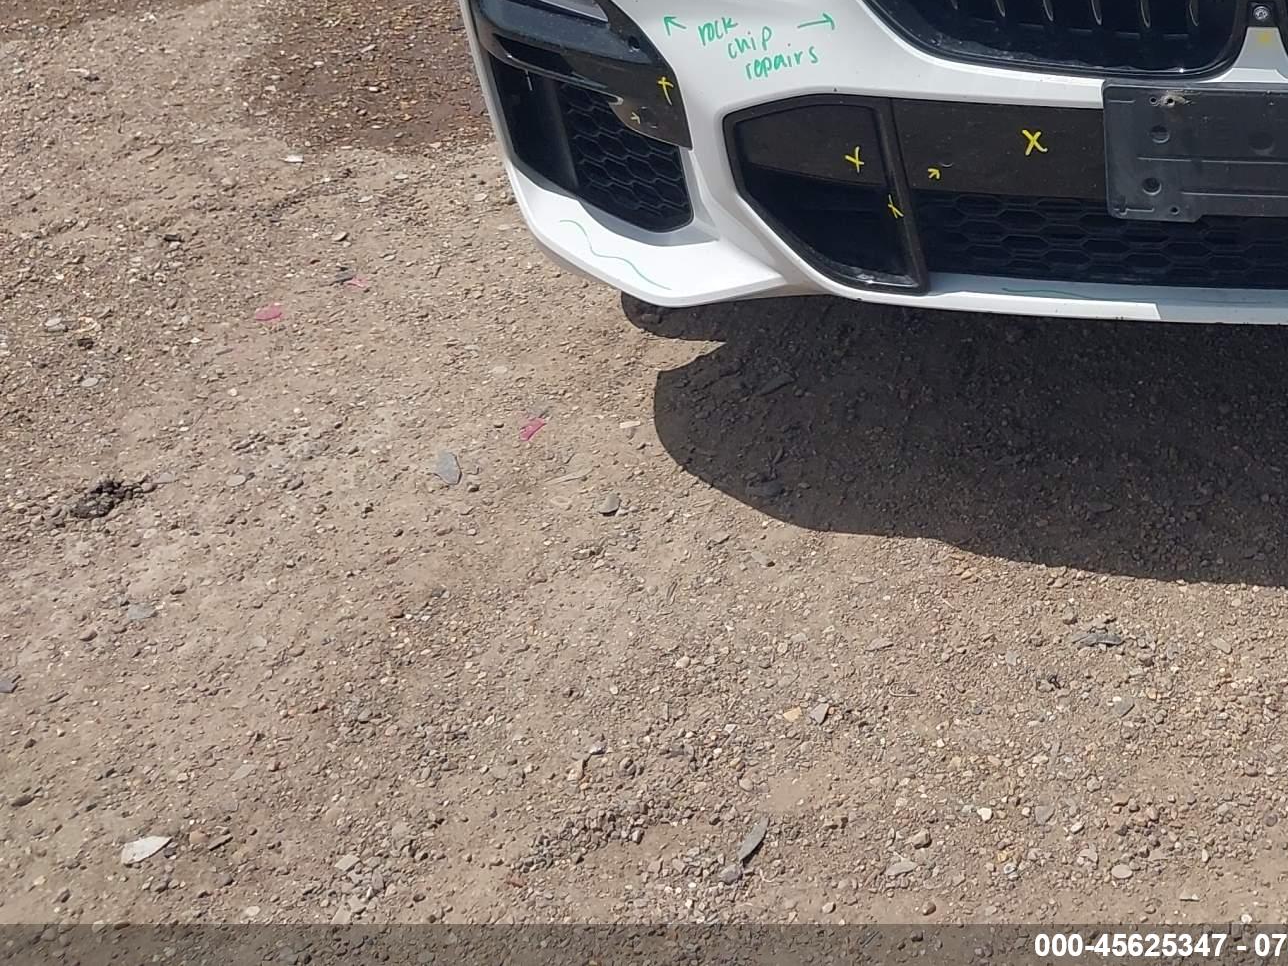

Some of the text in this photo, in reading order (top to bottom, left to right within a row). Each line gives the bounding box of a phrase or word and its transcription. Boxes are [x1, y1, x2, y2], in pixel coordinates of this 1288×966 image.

[698, 17, 738, 46] rock
[727, 26, 772, 59] chip
[745, 43, 818, 80] repairs
